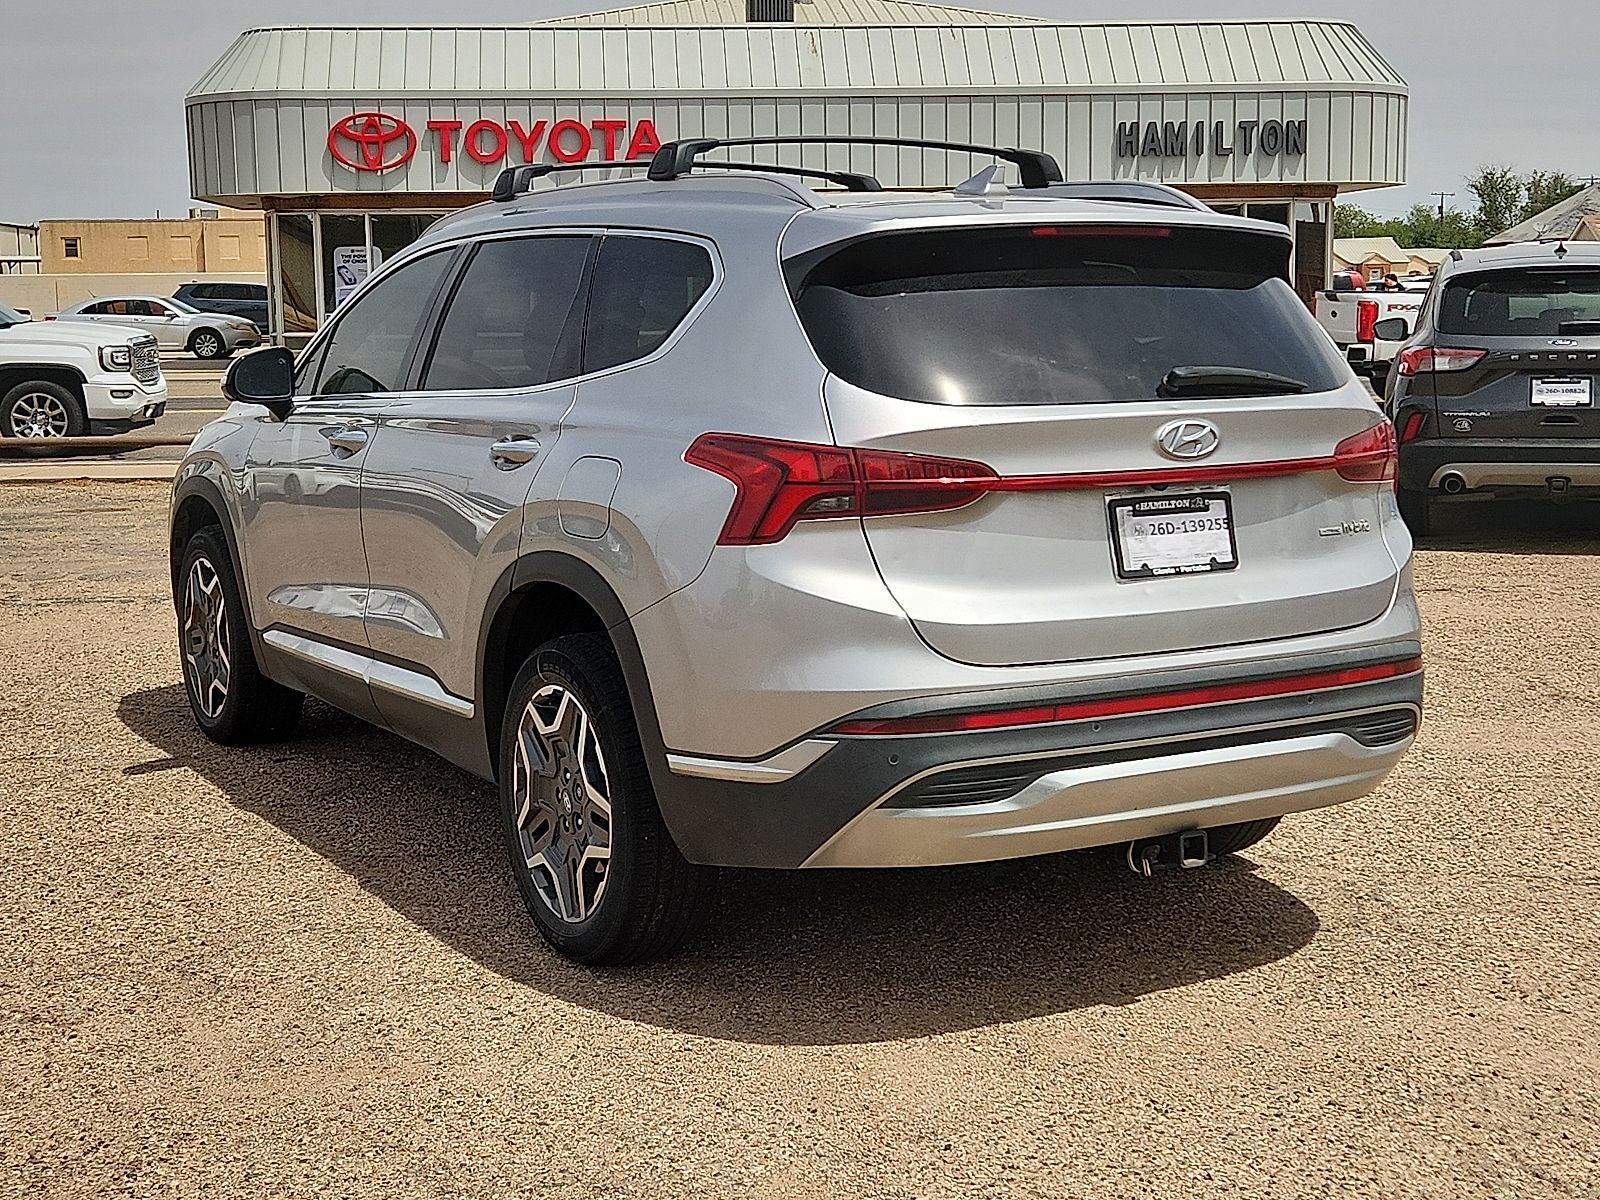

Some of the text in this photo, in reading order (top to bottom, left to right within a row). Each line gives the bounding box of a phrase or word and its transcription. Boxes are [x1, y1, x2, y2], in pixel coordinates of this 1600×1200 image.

[426, 119, 662, 164] TOYOTA
[1118, 120, 1307, 157] HAMILTON
[1140, 499, 1190, 511] HAMILTON
[1149, 518, 1229, 536] 26D-139255
